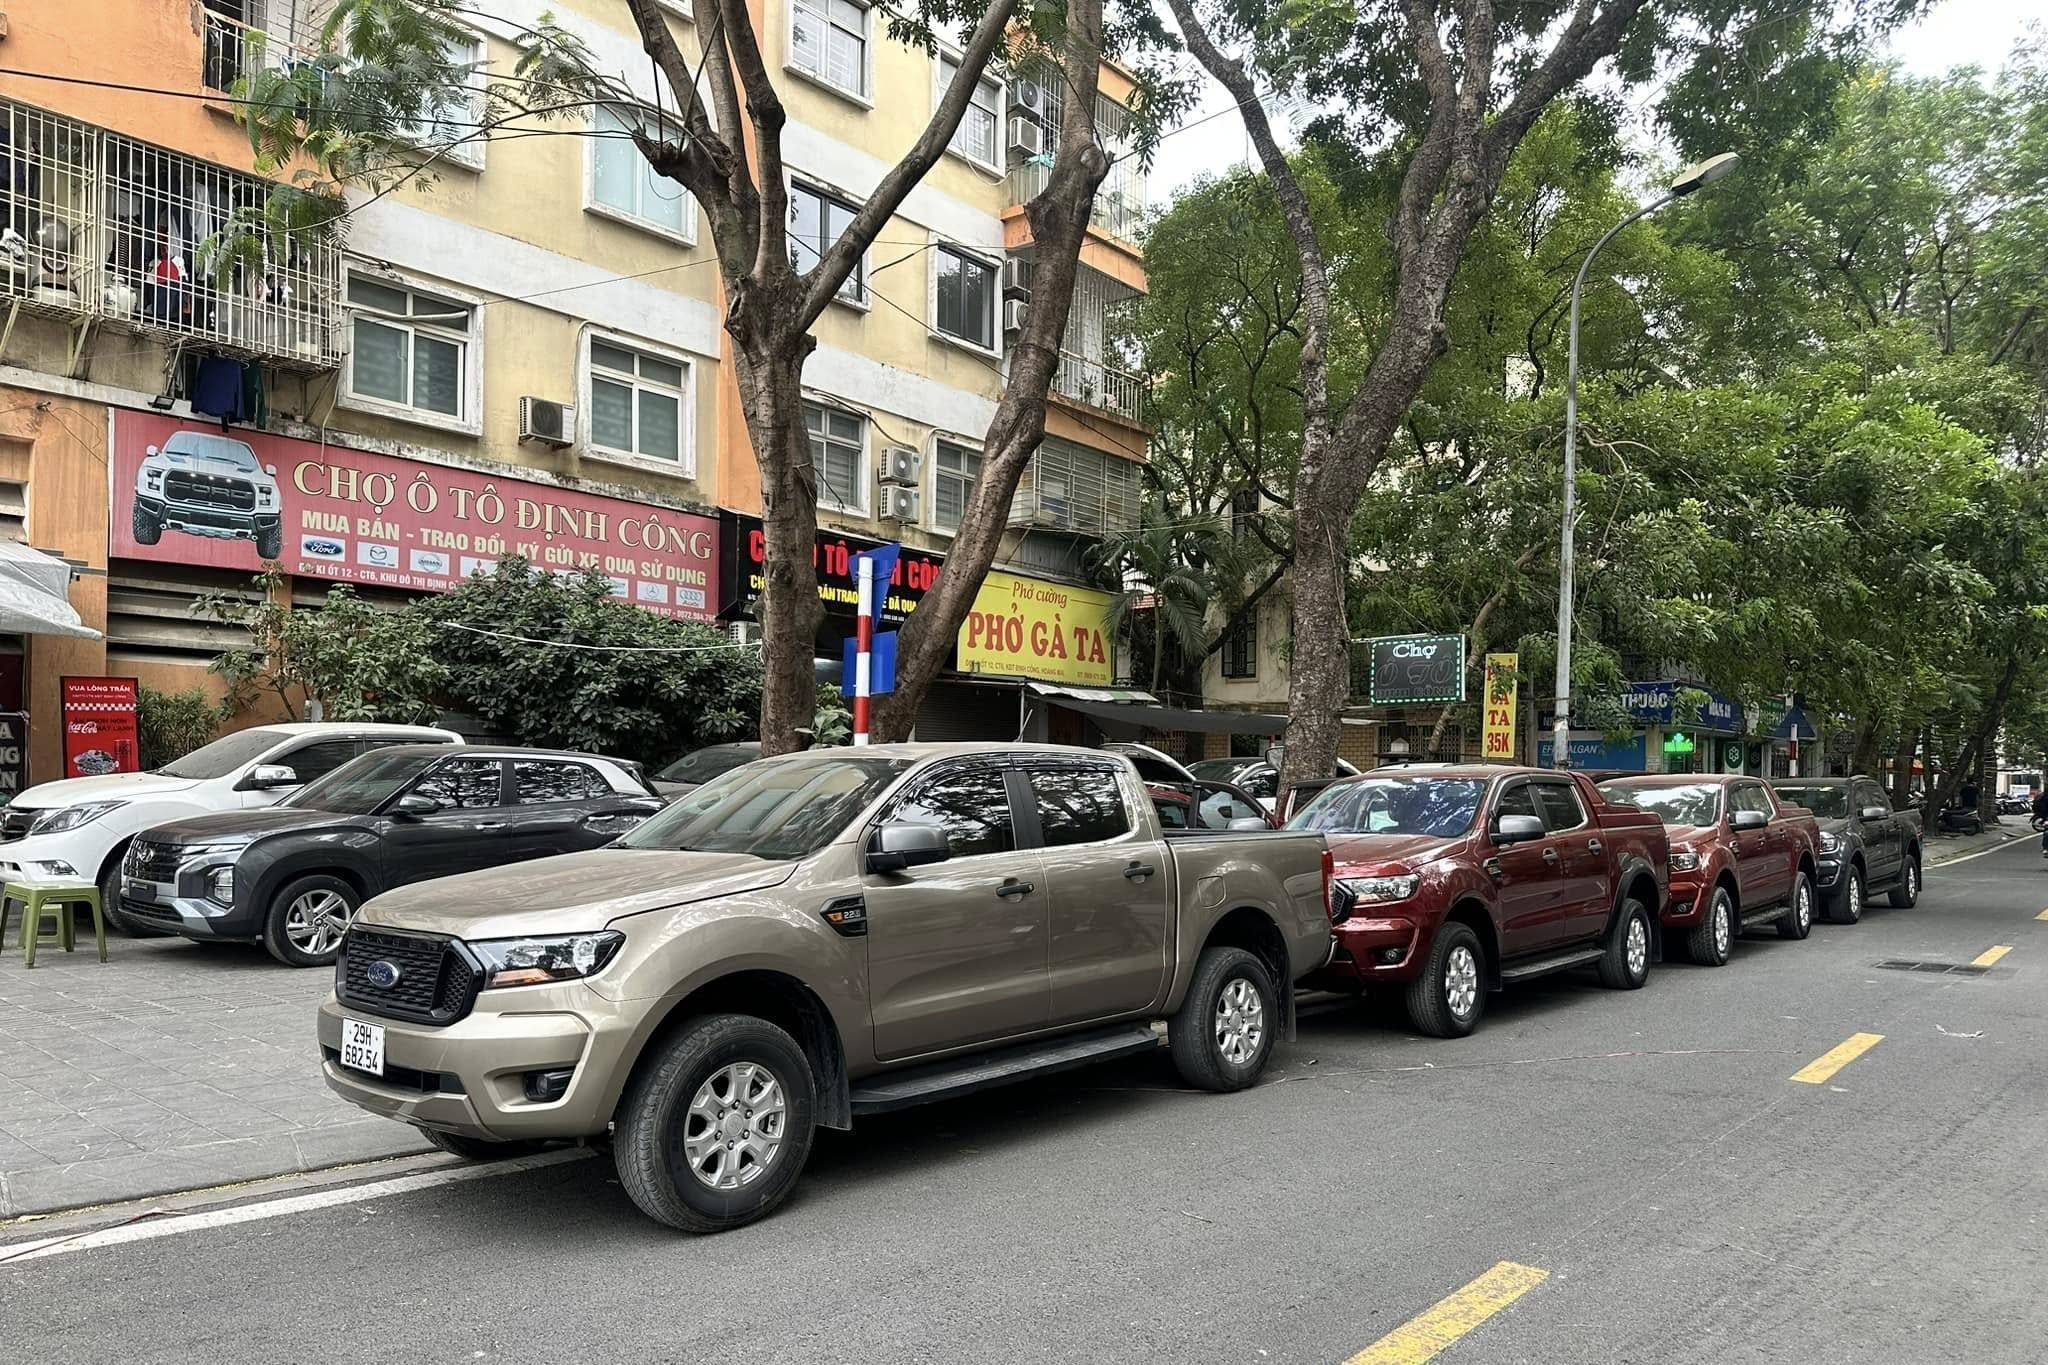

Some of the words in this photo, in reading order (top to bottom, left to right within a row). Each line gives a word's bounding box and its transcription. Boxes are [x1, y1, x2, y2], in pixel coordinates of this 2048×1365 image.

[293, 461, 397, 515] CHỢ
[407, 471, 439, 513] Ô
[449, 483, 505, 524] TÔ
[515, 498, 609, 541] ĐỊNH
[618, 513, 712, 560] CÔNG
[302, 510, 350, 534] MUA
[357, 518, 400, 541] BÁN
[420, 528, 468, 550] TRAO
[579, 553, 599, 570] XE
[605, 556, 636, 575] QUA
[641, 558, 663, 579] SỬ
[666, 565, 707, 587] DỤNG
[824, 540, 848, 576] TÔ
[341, 568, 352, 578] 12
[380, 572, 397, 584] KHU
[967, 602, 1025, 653] PHỞ
[1031, 613, 1068, 660] GÀ
[1074, 627, 1106, 664] TA
[1393, 643, 1438, 659] Chợ
[1488, 710, 1510, 726] TA
[1487, 732, 1509, 752] 35K
[353, 1023, 372, 1045] 29H
[345, 1044, 379, 1071] 682.54
